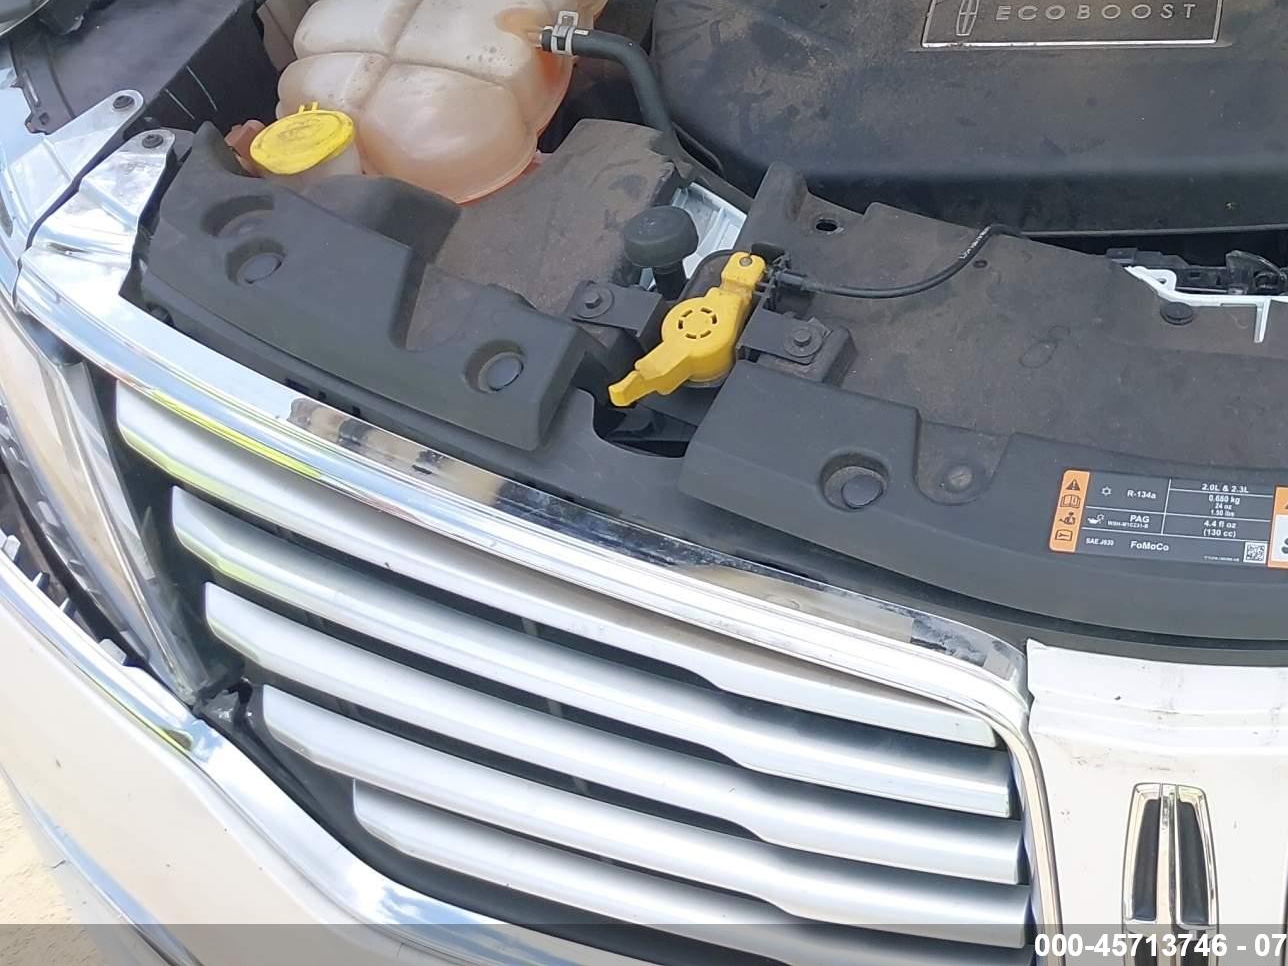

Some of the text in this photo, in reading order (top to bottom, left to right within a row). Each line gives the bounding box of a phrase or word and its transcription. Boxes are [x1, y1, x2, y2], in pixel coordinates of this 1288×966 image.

[995, 3, 1197, 21] ECOBOOST
[1201, 482, 1249, 494] 2.0L & 2.3L
[1127, 488, 1157, 500] R-134a
[1231, 495, 1241, 506] kg
[1129, 514, 1150, 523] PAG
[1203, 520, 1237, 530] 4.4 fl oz
[1203, 528, 1237, 539] (130 cc)
[1130, 540, 1169, 551] FoMoCo
